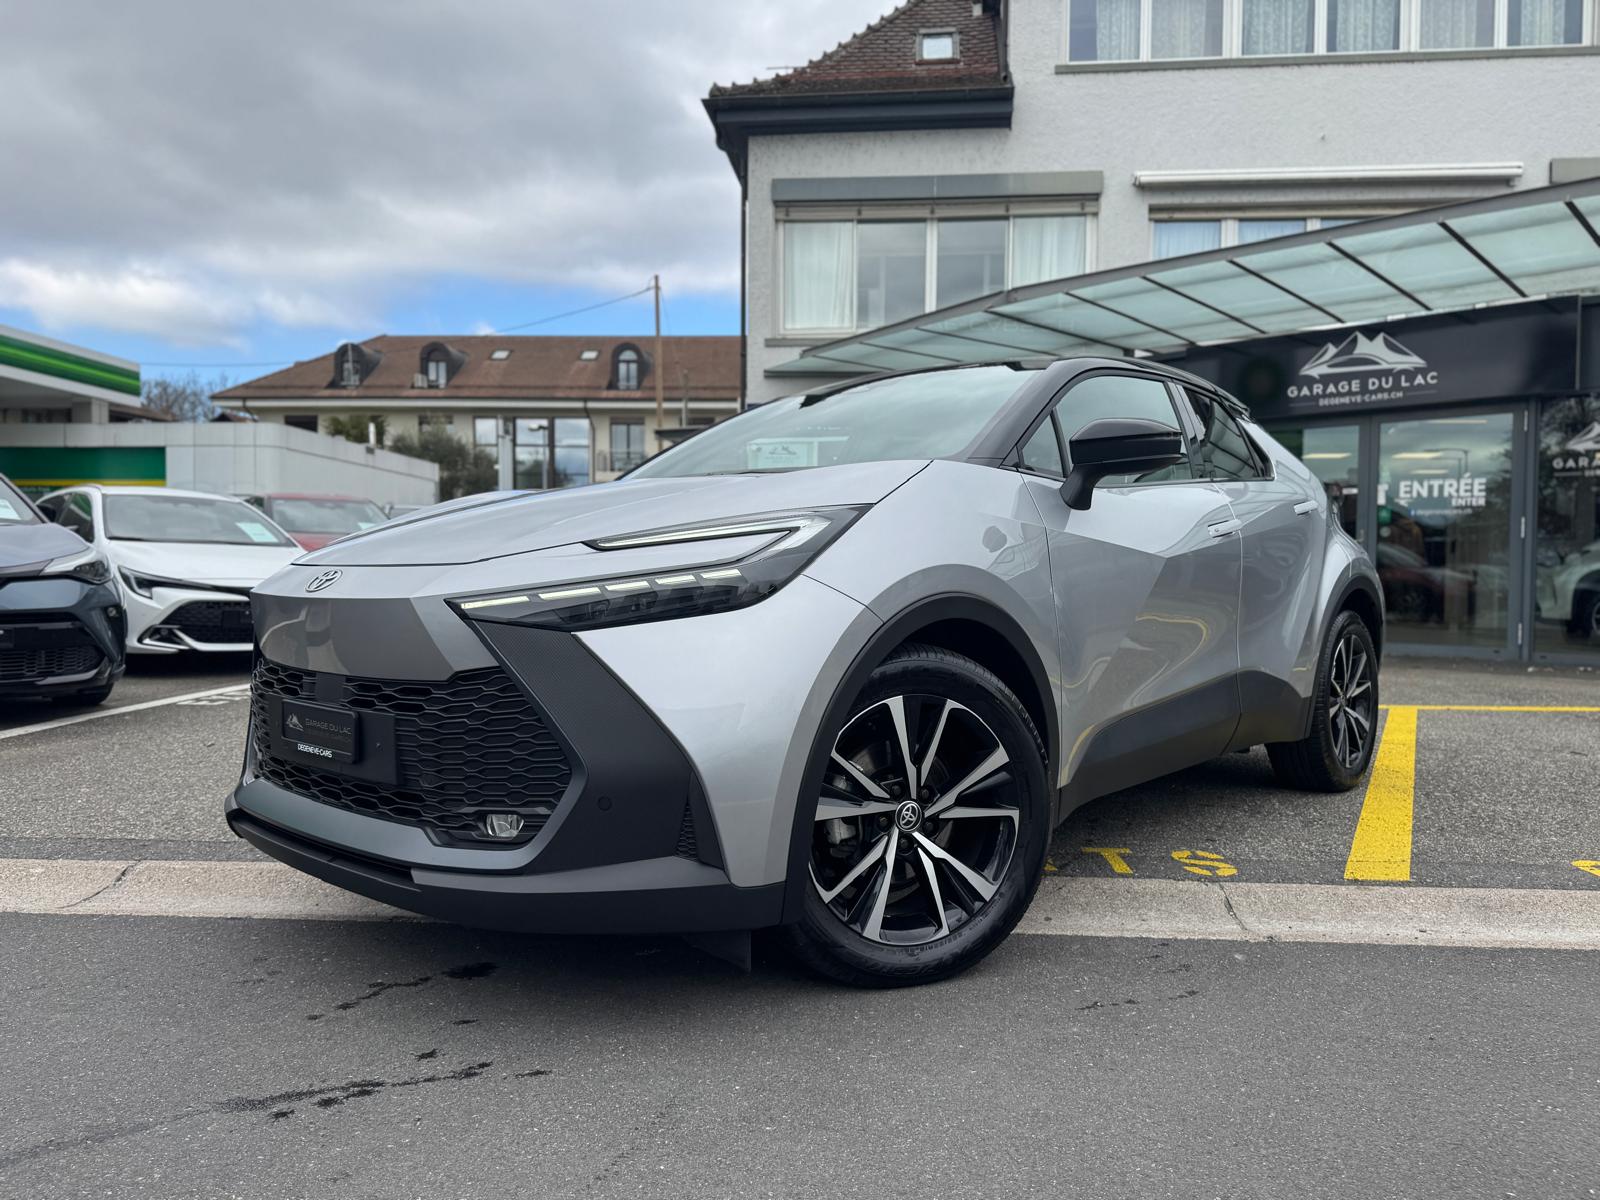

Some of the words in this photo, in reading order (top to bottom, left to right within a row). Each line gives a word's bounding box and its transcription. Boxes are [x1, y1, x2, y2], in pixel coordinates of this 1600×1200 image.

[1287, 379, 1361, 398] GARAGE
[1368, 376, 1393, 390] DU
[1400, 371, 1439, 387] LAC
[1399, 472, 1487, 498] ENTRÉE
[1451, 497, 1486, 507] ENTER
